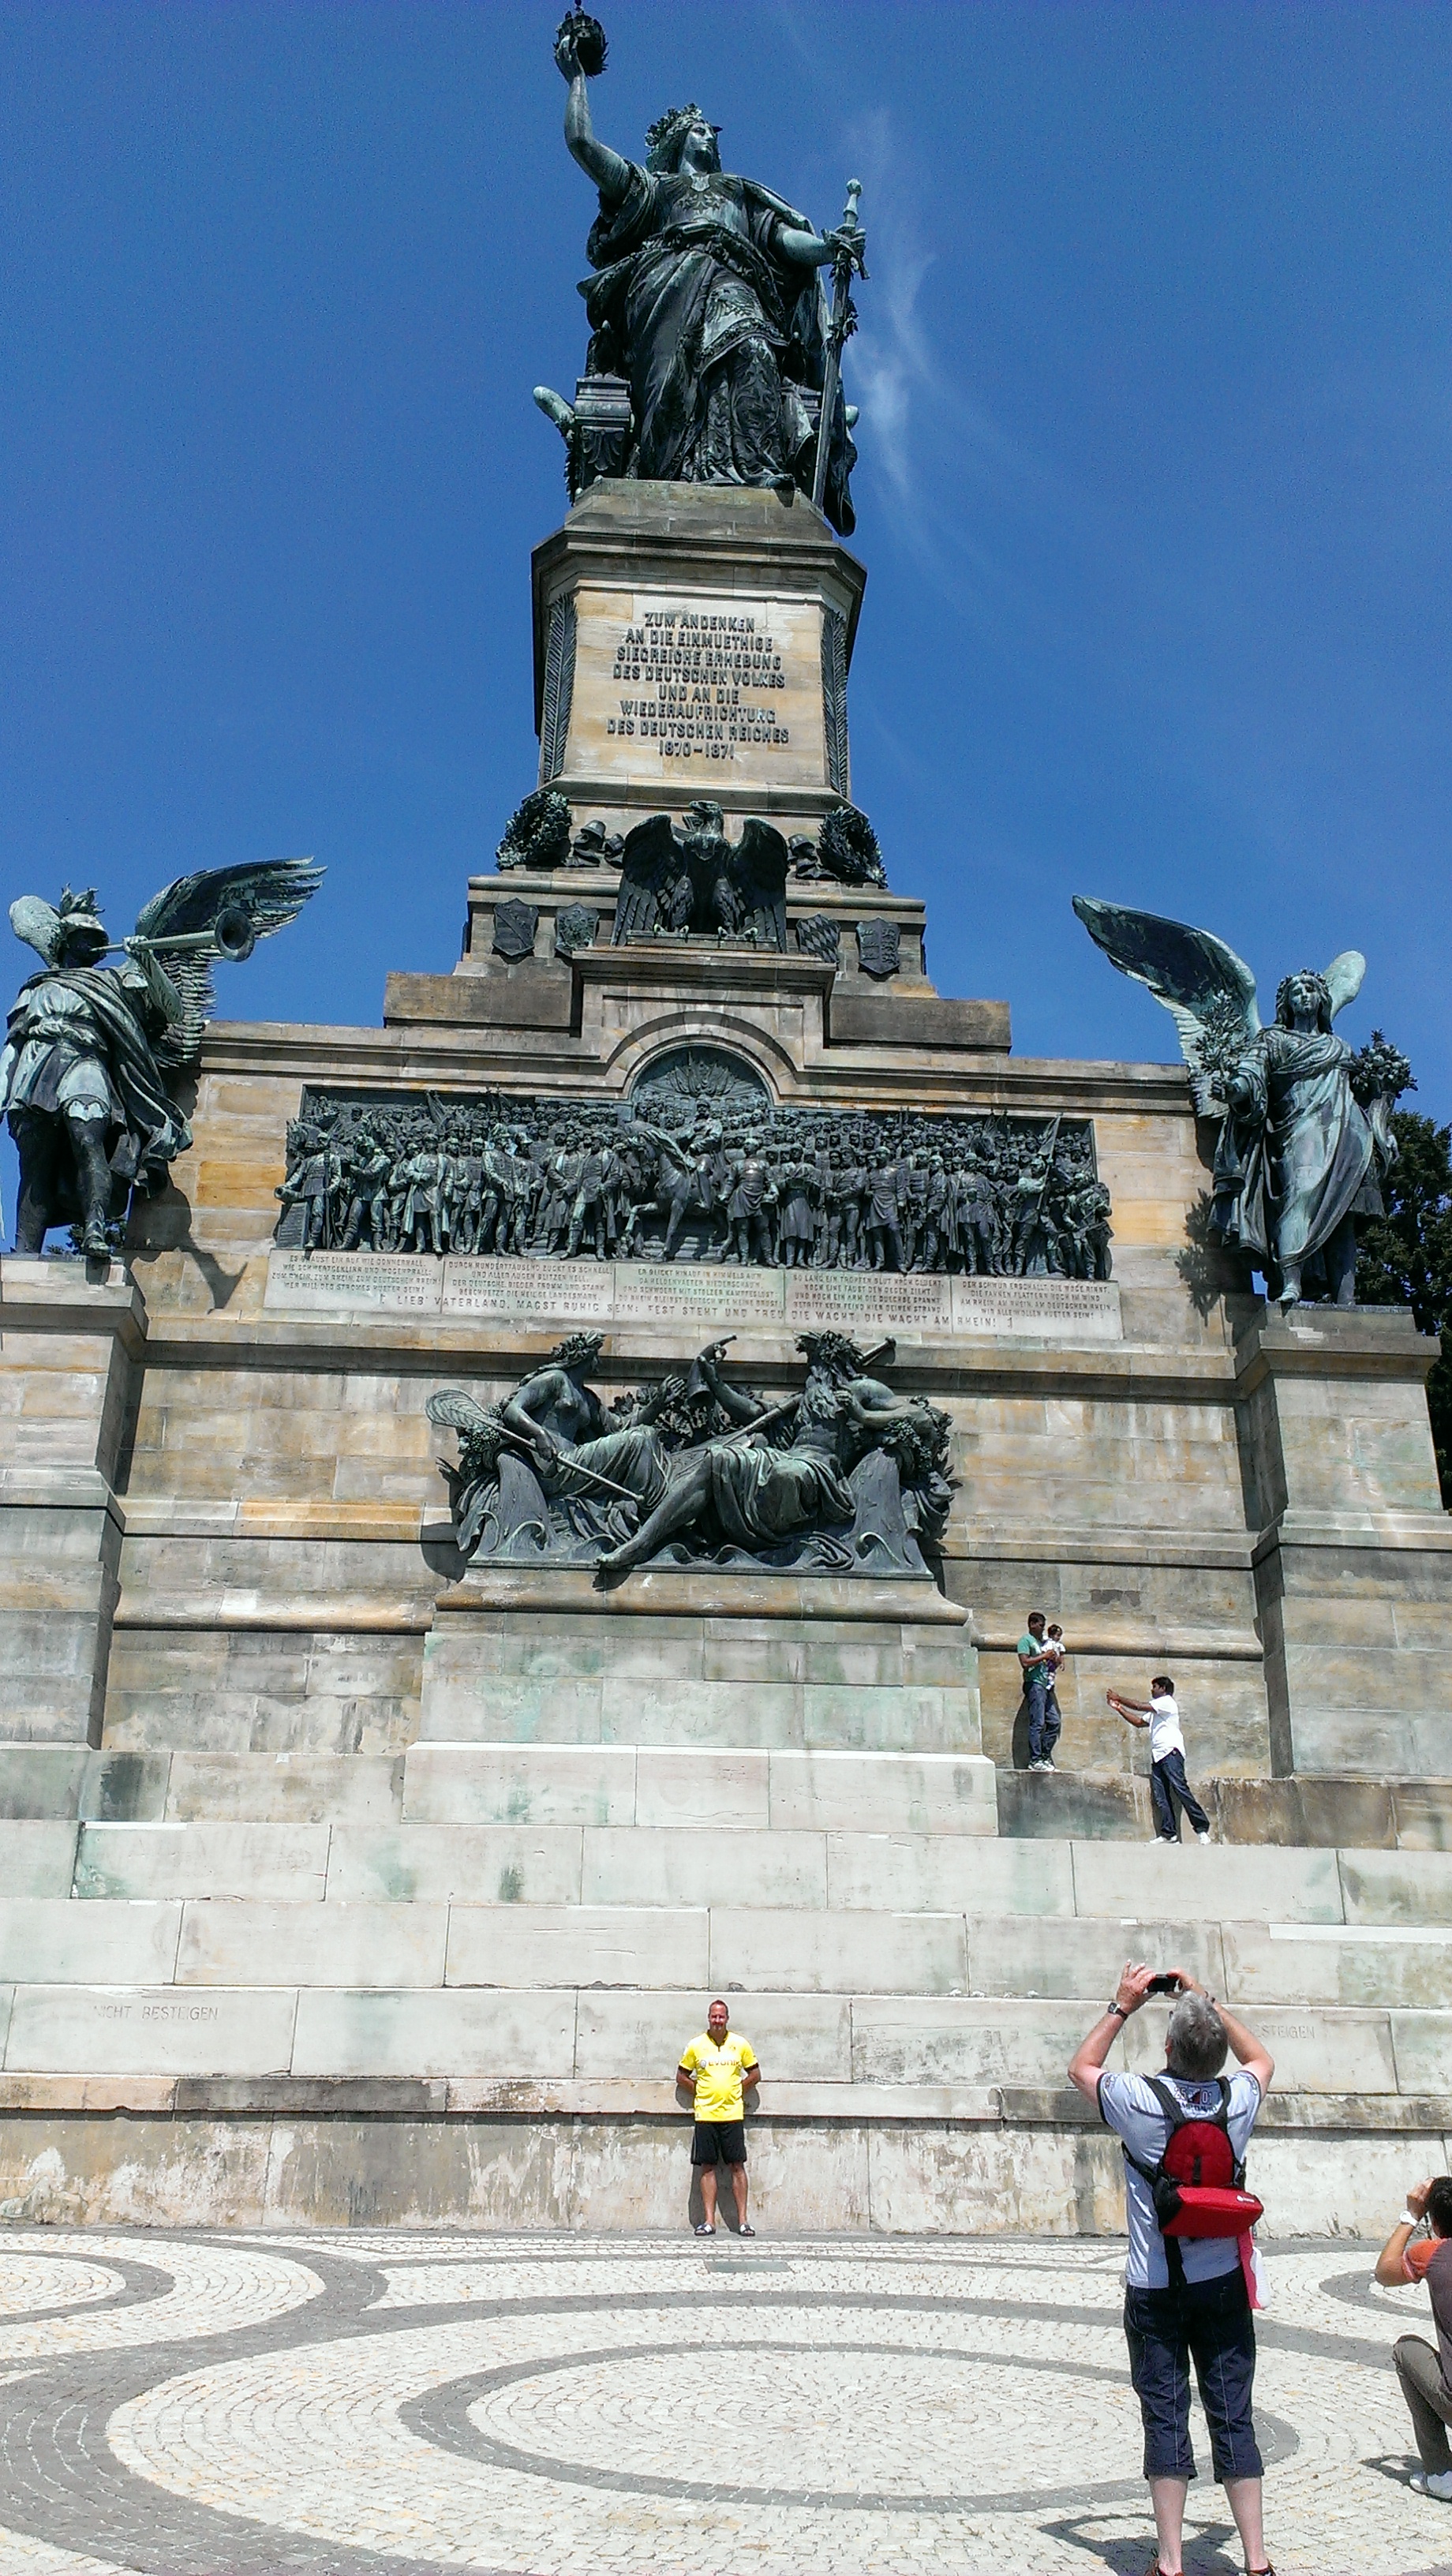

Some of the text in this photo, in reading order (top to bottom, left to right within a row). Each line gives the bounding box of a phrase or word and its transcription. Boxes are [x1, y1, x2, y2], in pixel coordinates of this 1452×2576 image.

[646, 612, 754, 633] ZUM ANDENKEN
[626, 628, 773, 652] AN DIE EINMUETHIGE
[617, 646, 780, 671] SIEGREICHE ERHEBUNG
[613, 664, 784, 689] DES DEUTSCHEN VOLKES
[659, 684, 739, 705] UND AN DIE
[619, 700, 775, 724] WIEDERAUFRICHTUNG
[608, 718, 788, 743] DES DEUTSCHEN REICHES
[517, 1300, 556, 1310] MAGST
[563, 1301, 599, 1312] RUHIG
[649, 1305, 675, 1316] FEST
[683, 1306, 717, 1317] STEHT
[725, 1308, 747, 1318] UND
[755, 1309, 784, 1320] TREU
[791, 1310, 810, 1320] DIE
[865, 1313, 883, 1324] DIE
[889, 1314, 928, 1325] WACHT
[934, 1316, 949, 1325] AM
[142, 2005, 219, 2021] BESTEIGEN
